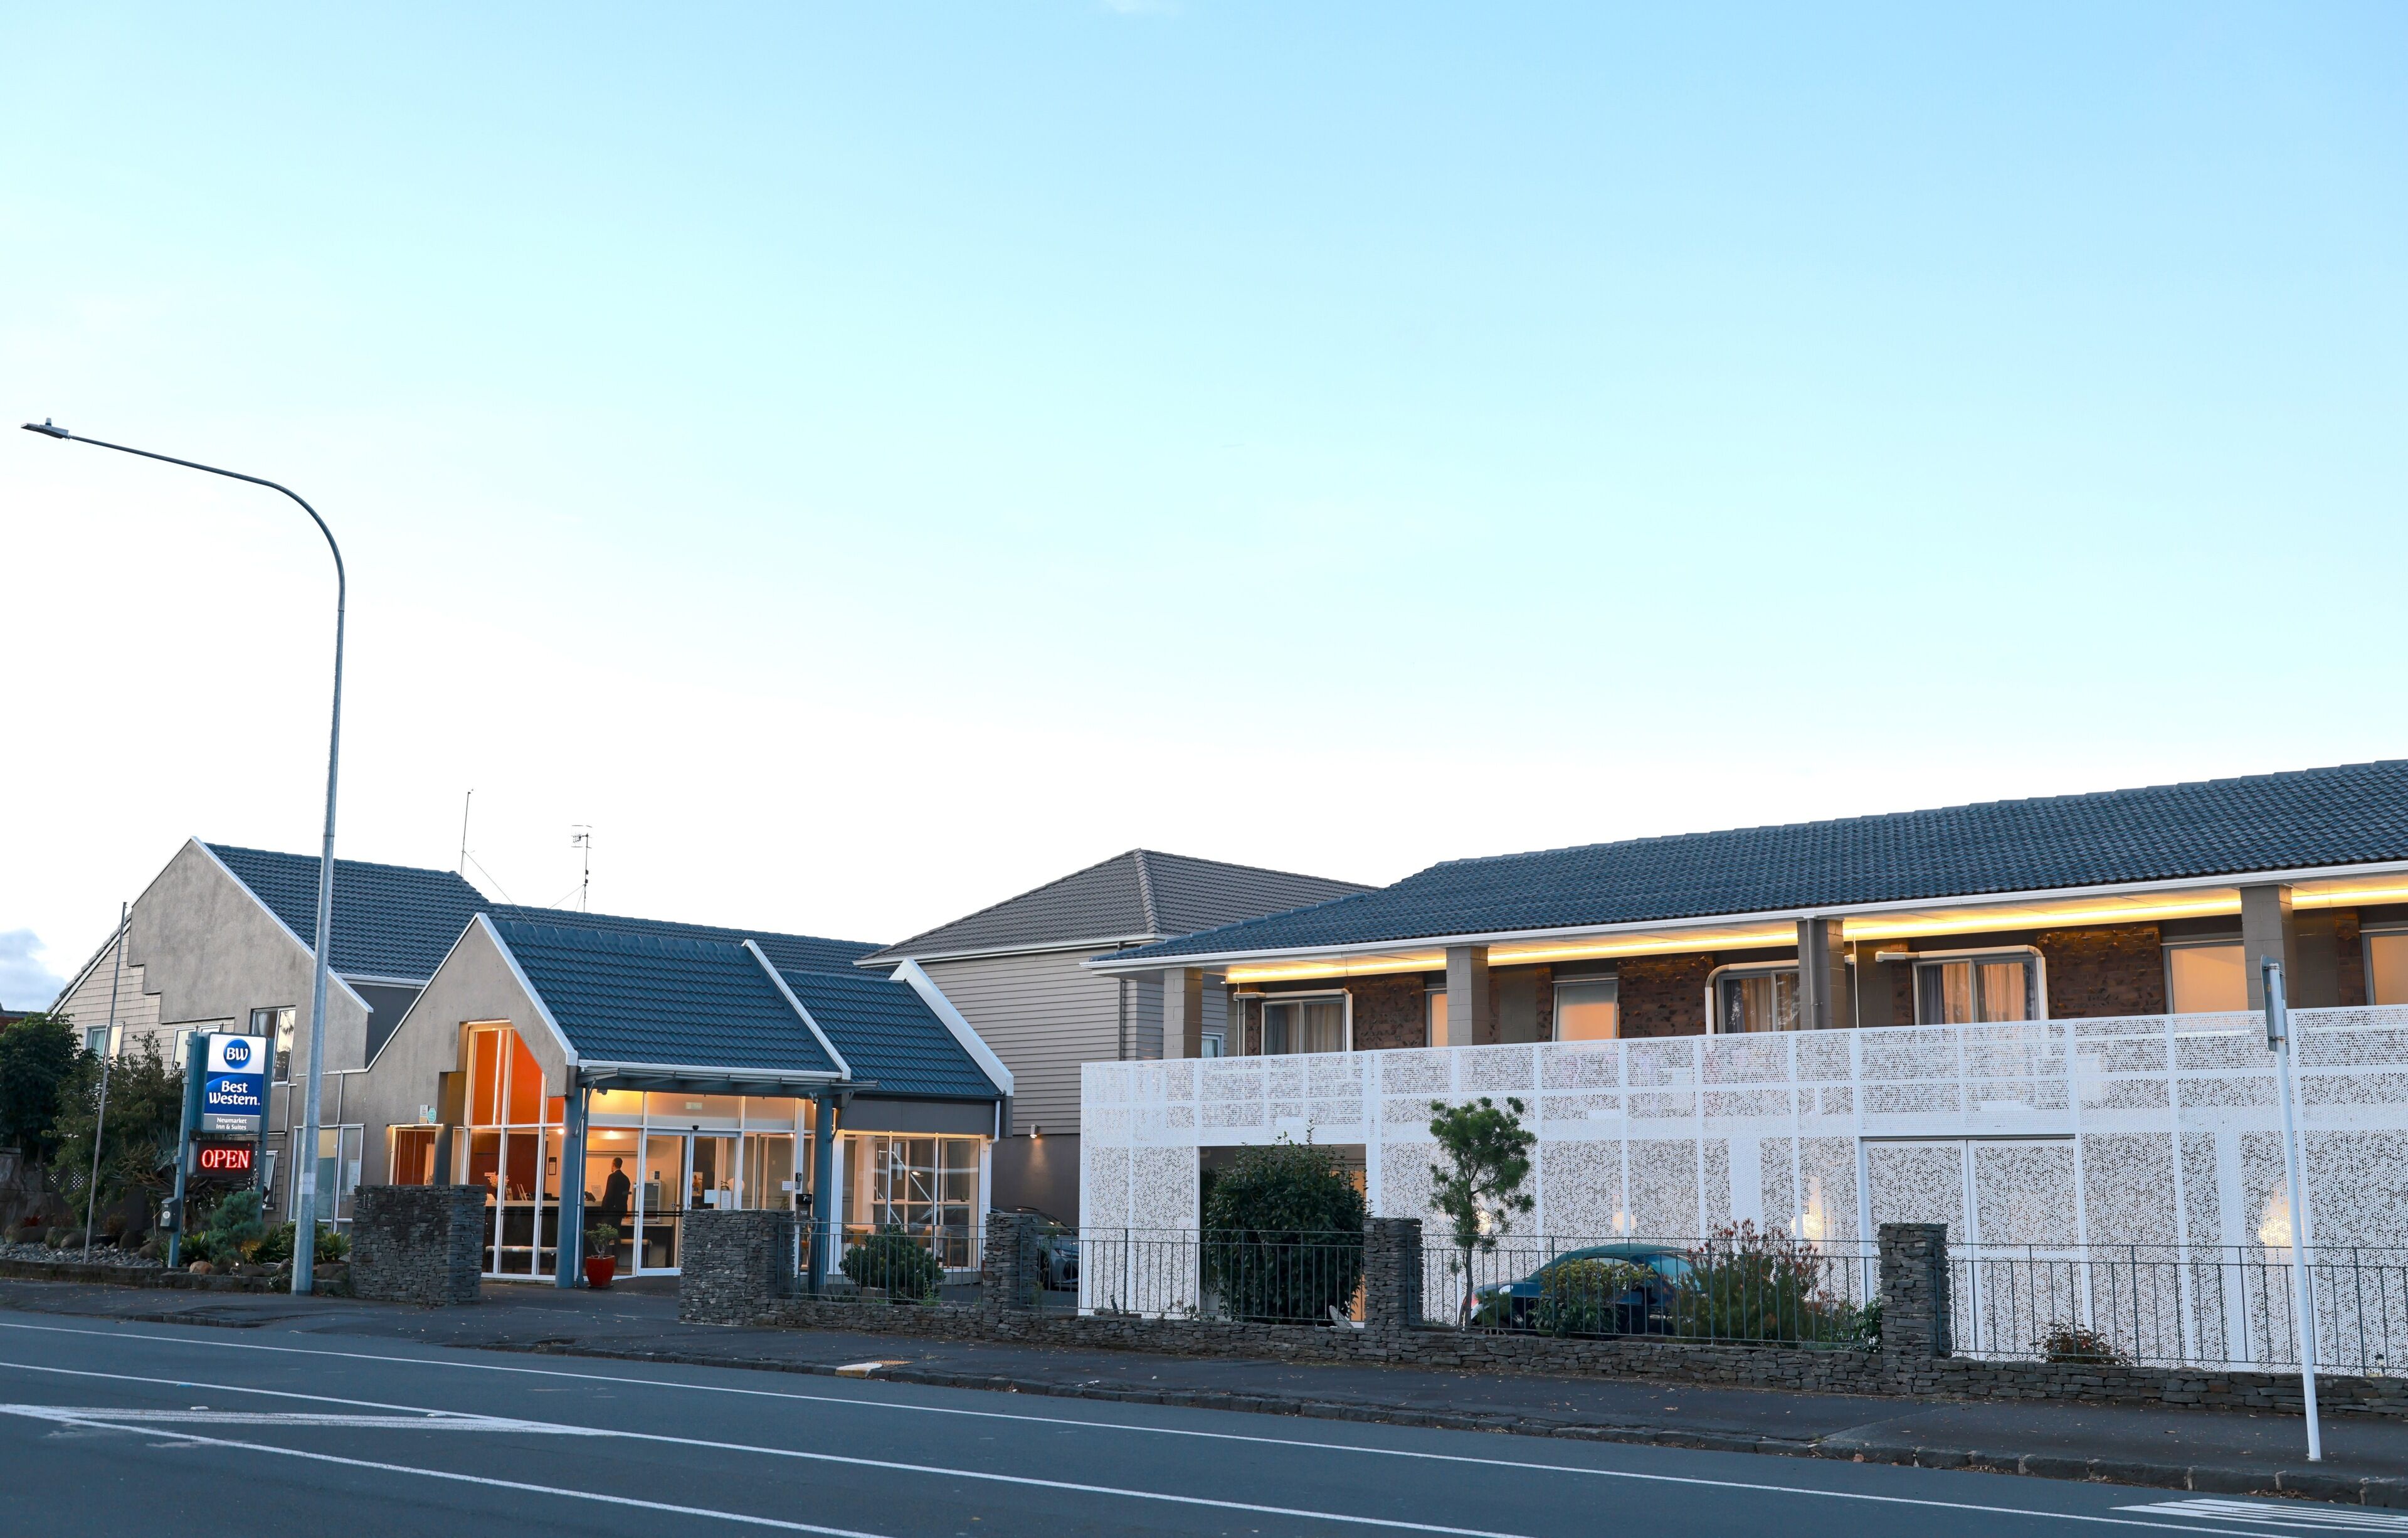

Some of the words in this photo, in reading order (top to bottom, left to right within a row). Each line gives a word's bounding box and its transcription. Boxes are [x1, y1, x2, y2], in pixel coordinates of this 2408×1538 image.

[226, 1047, 249, 1061] BW
[221, 1080, 248, 1093] Best
[201, 1149, 250, 1169] OPEN
